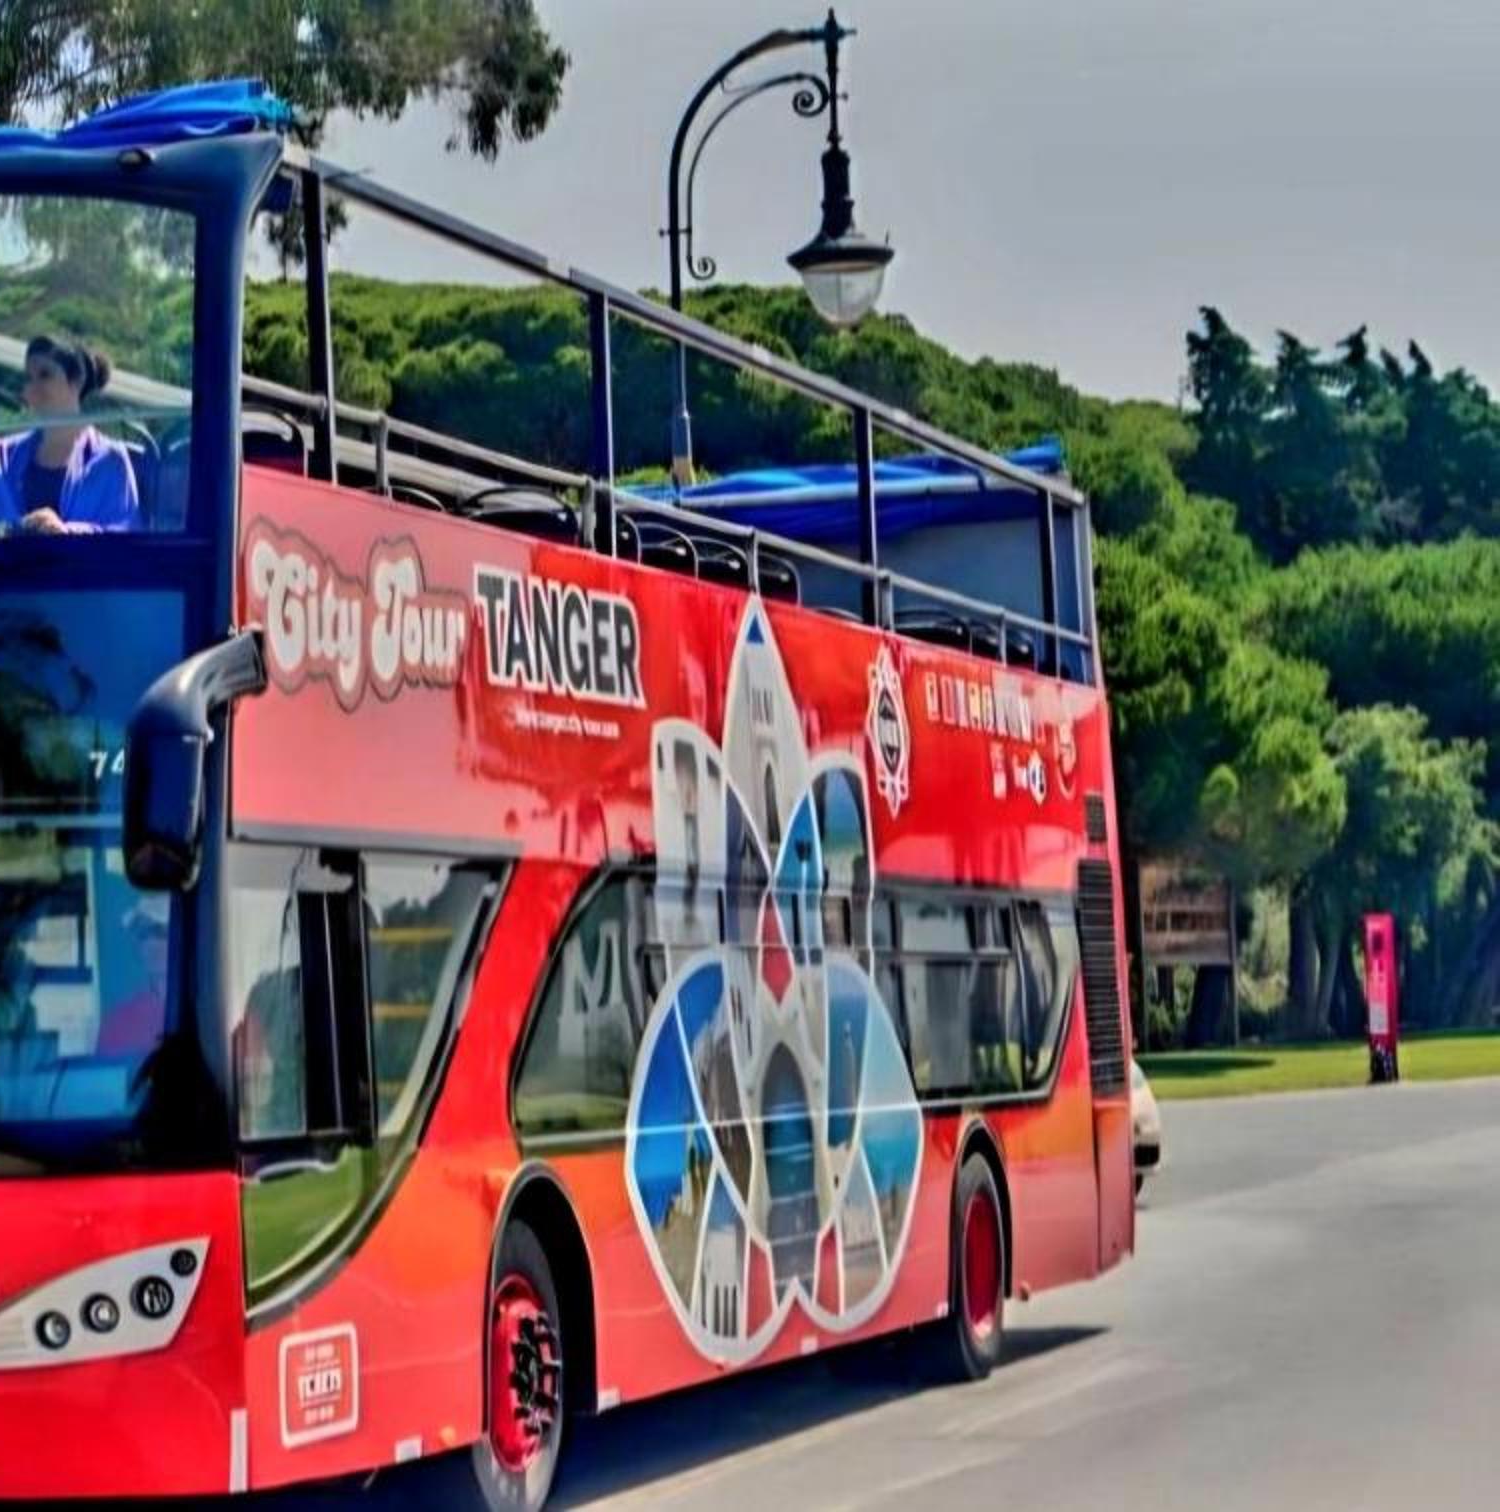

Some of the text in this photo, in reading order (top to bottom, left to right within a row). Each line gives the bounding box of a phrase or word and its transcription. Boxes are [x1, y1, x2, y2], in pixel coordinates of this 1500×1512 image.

[252, 538, 465, 692] City Tour
[477, 569, 640, 700] TANGER
